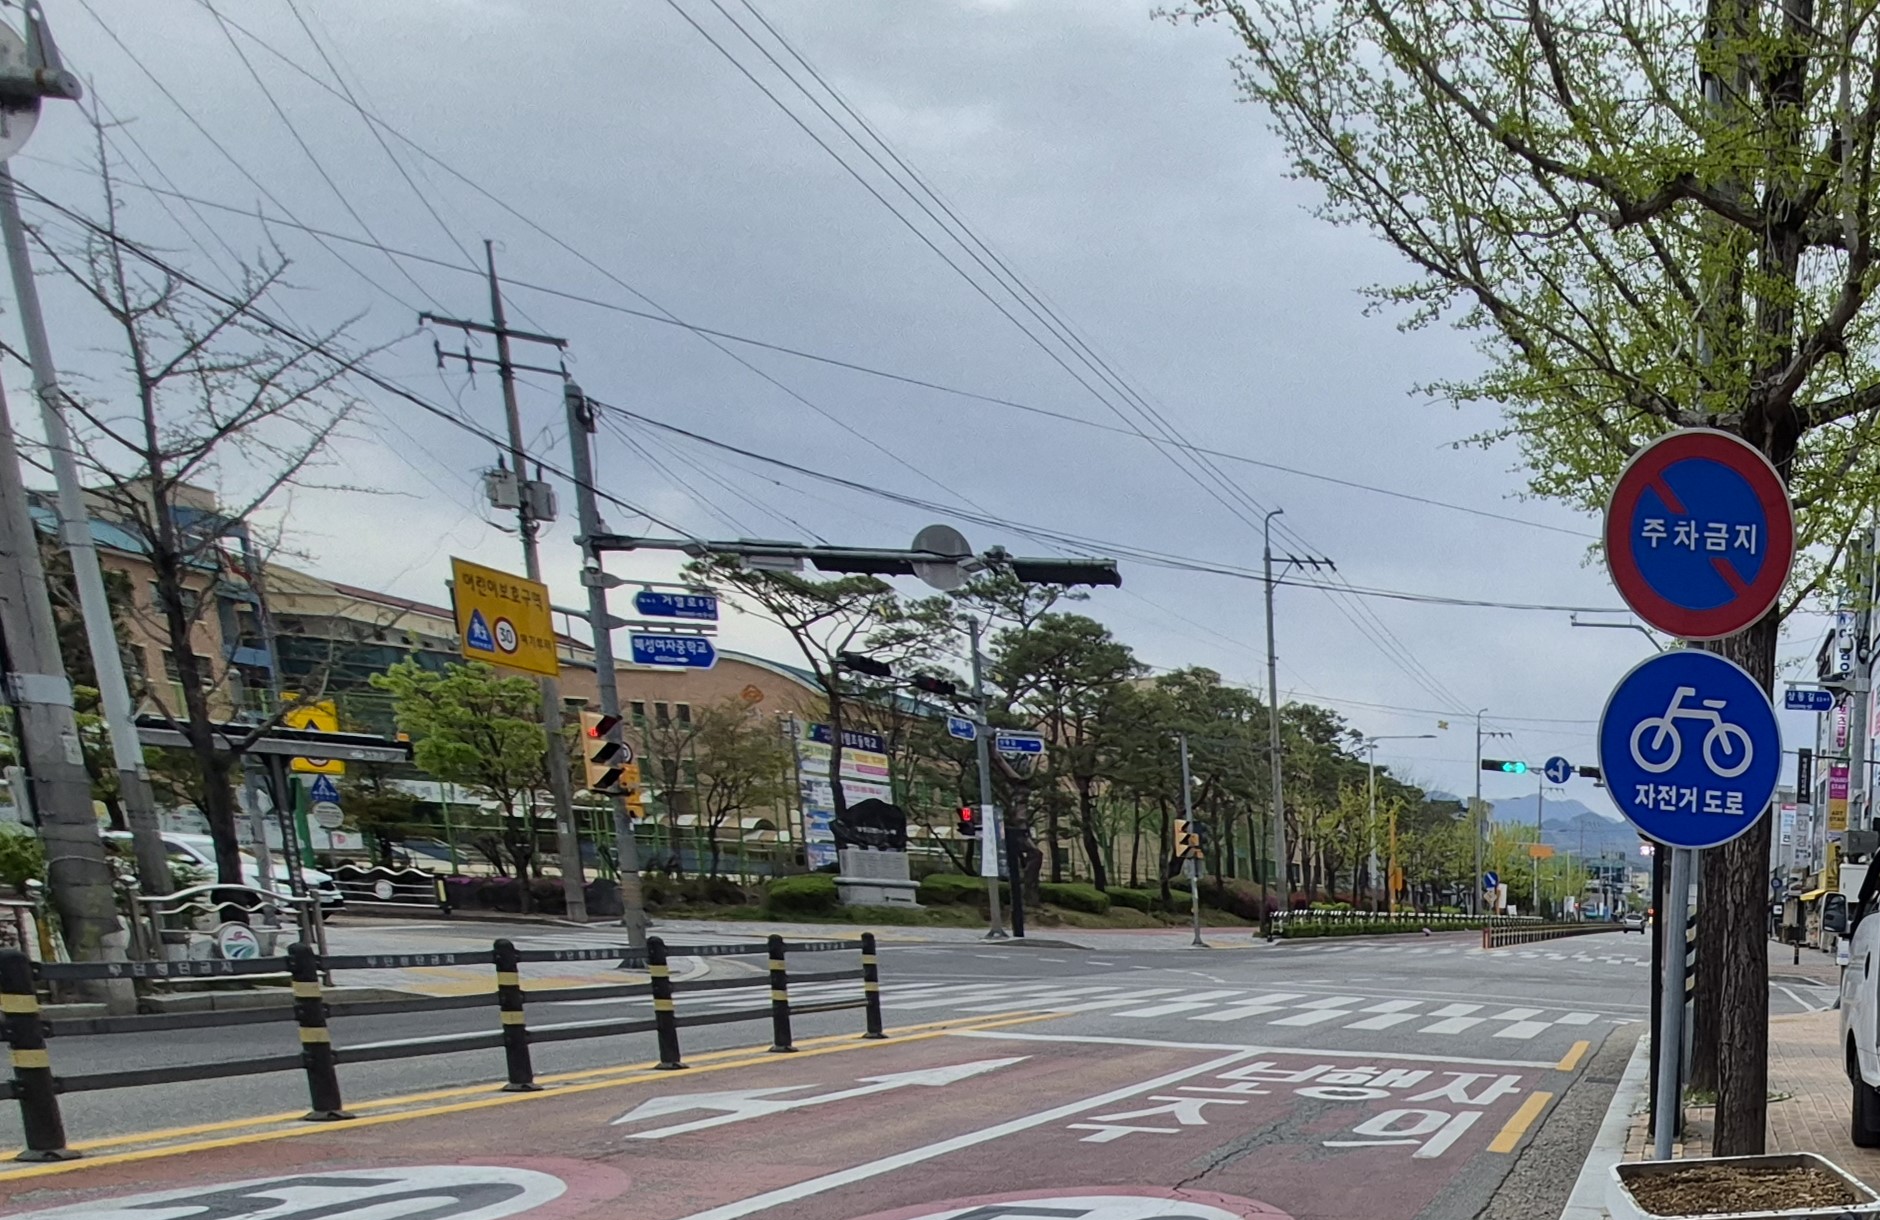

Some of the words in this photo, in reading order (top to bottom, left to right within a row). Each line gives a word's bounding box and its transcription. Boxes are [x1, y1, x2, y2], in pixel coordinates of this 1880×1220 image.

[1641, 518, 1758, 555] 주차금지
[462, 573, 543, 612] 어린이보호구역
[499, 627, 513, 644] 30
[1177, 1061, 1523, 1106] 보행자
[1066, 1095, 1484, 1160] 주의
